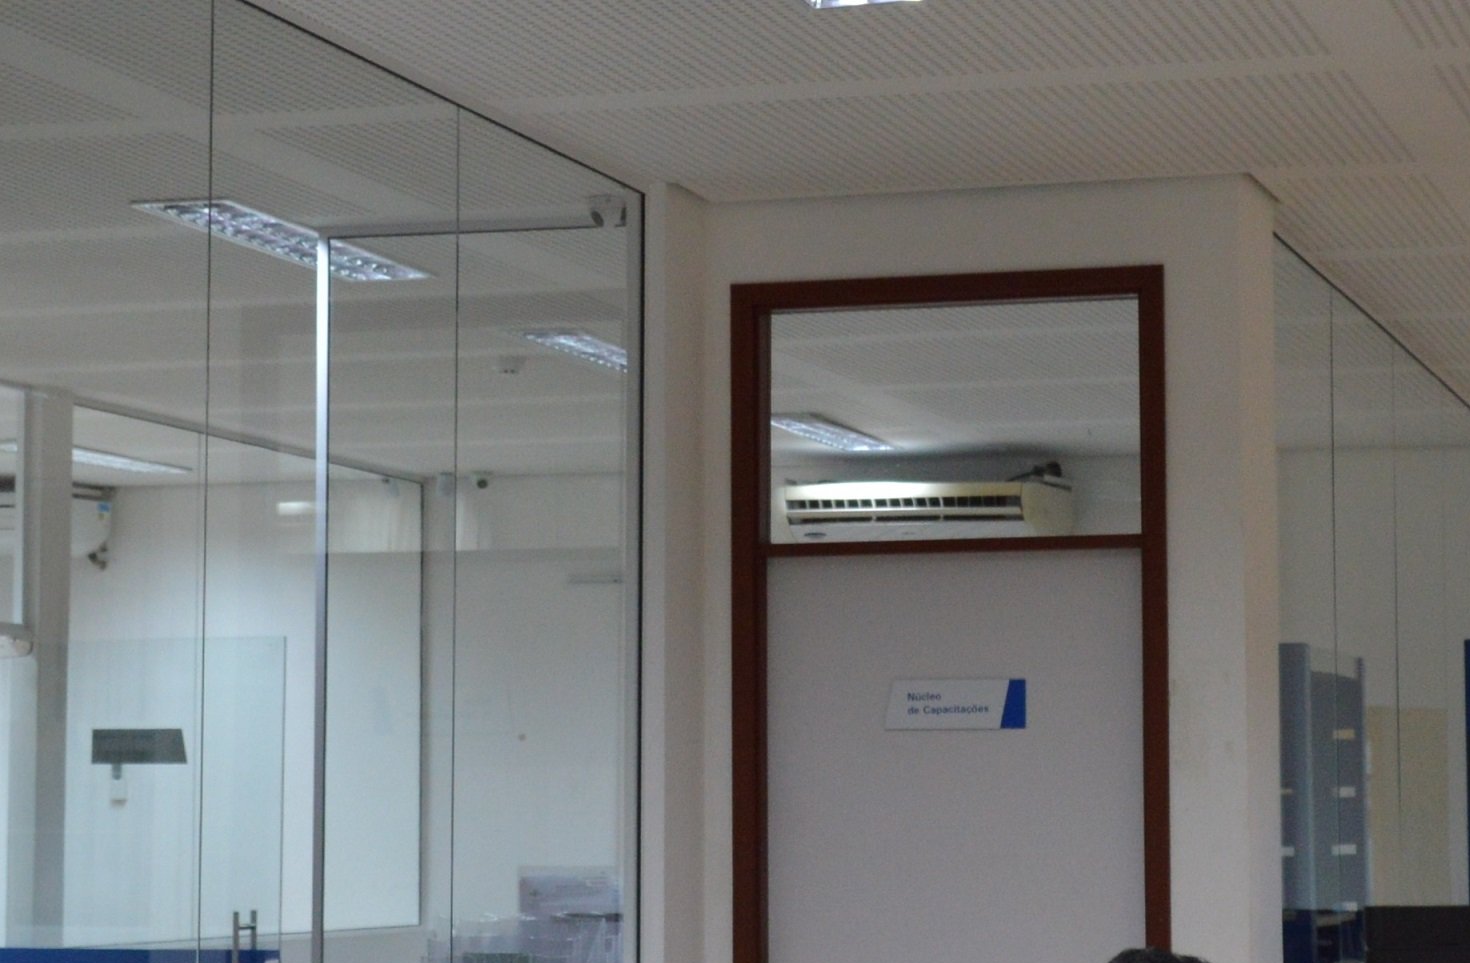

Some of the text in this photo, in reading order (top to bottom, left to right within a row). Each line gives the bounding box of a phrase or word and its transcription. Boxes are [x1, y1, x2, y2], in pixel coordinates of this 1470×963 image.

[907, 692, 942, 702] Núcleo
[908, 704, 990, 716] de Capacitações
